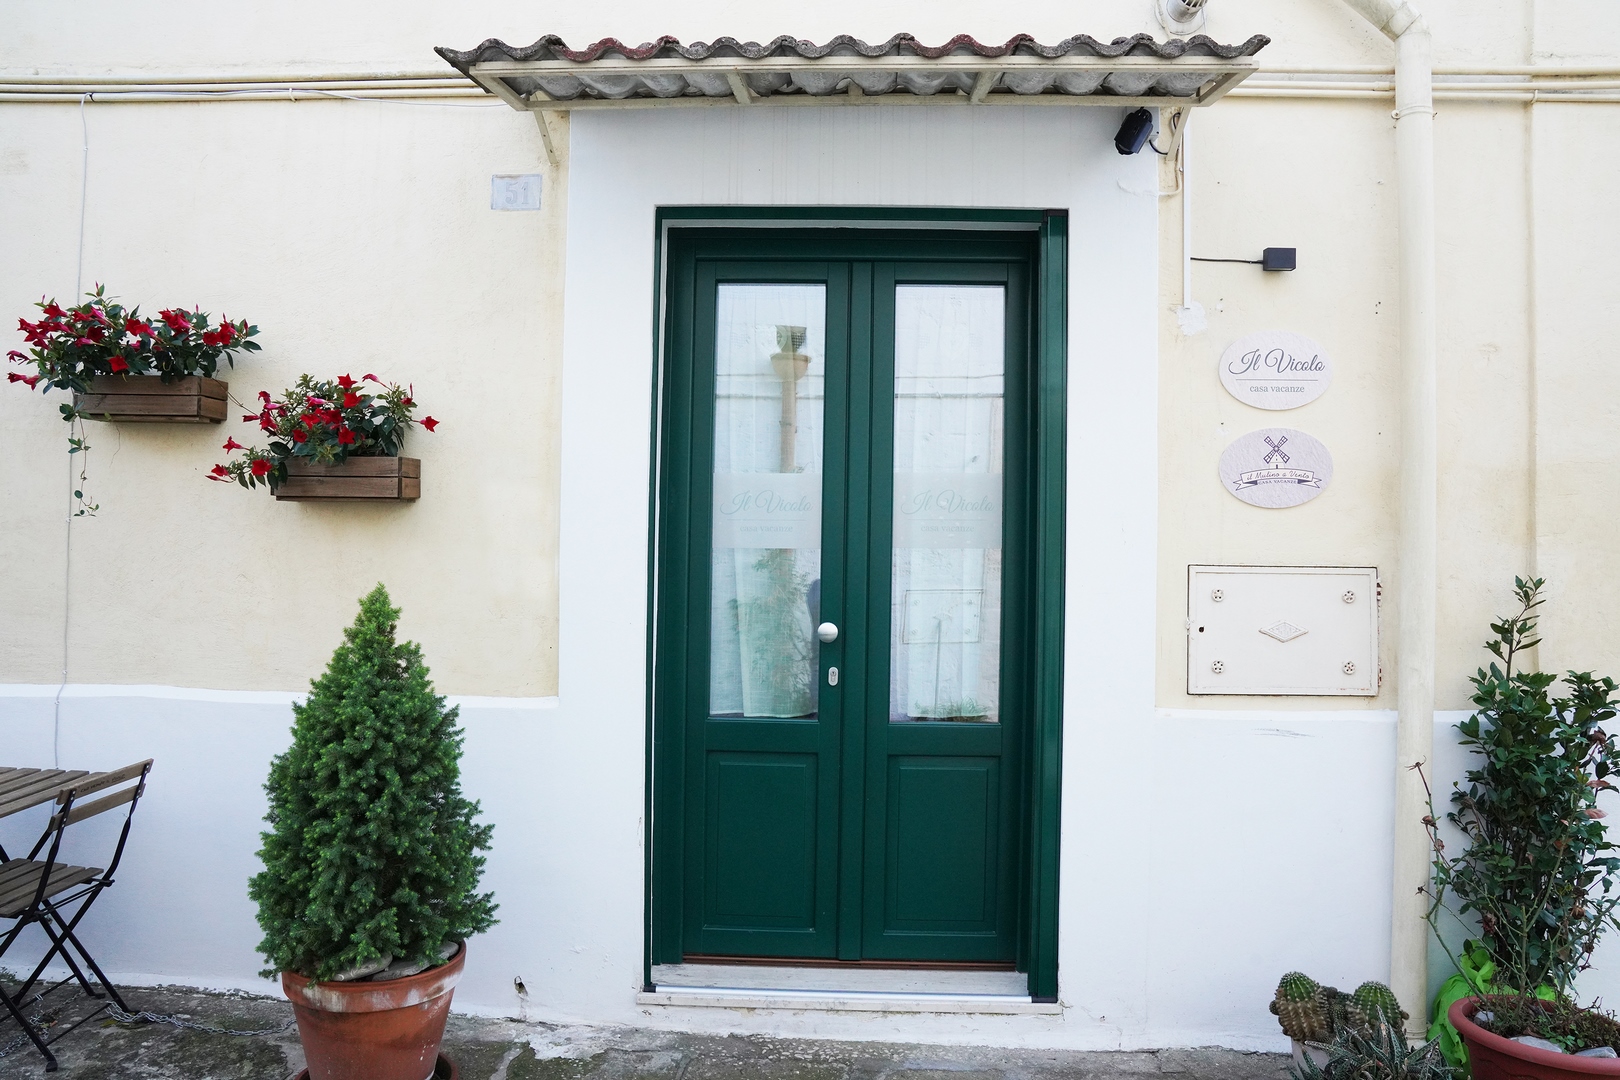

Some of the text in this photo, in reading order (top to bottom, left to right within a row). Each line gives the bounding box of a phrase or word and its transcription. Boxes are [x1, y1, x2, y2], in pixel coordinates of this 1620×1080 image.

[504, 181, 529, 205] 51
[1228, 348, 1325, 375] Il Vicolo
[1249, 385, 1305, 393] casa vacanze
[1289, 471, 1310, 479] Vento
[719, 489, 813, 515] Il Vicolo
[900, 489, 995, 515] Il Vicolo
[760, 525, 793, 533] vacanze
[941, 525, 975, 533] vacanze
